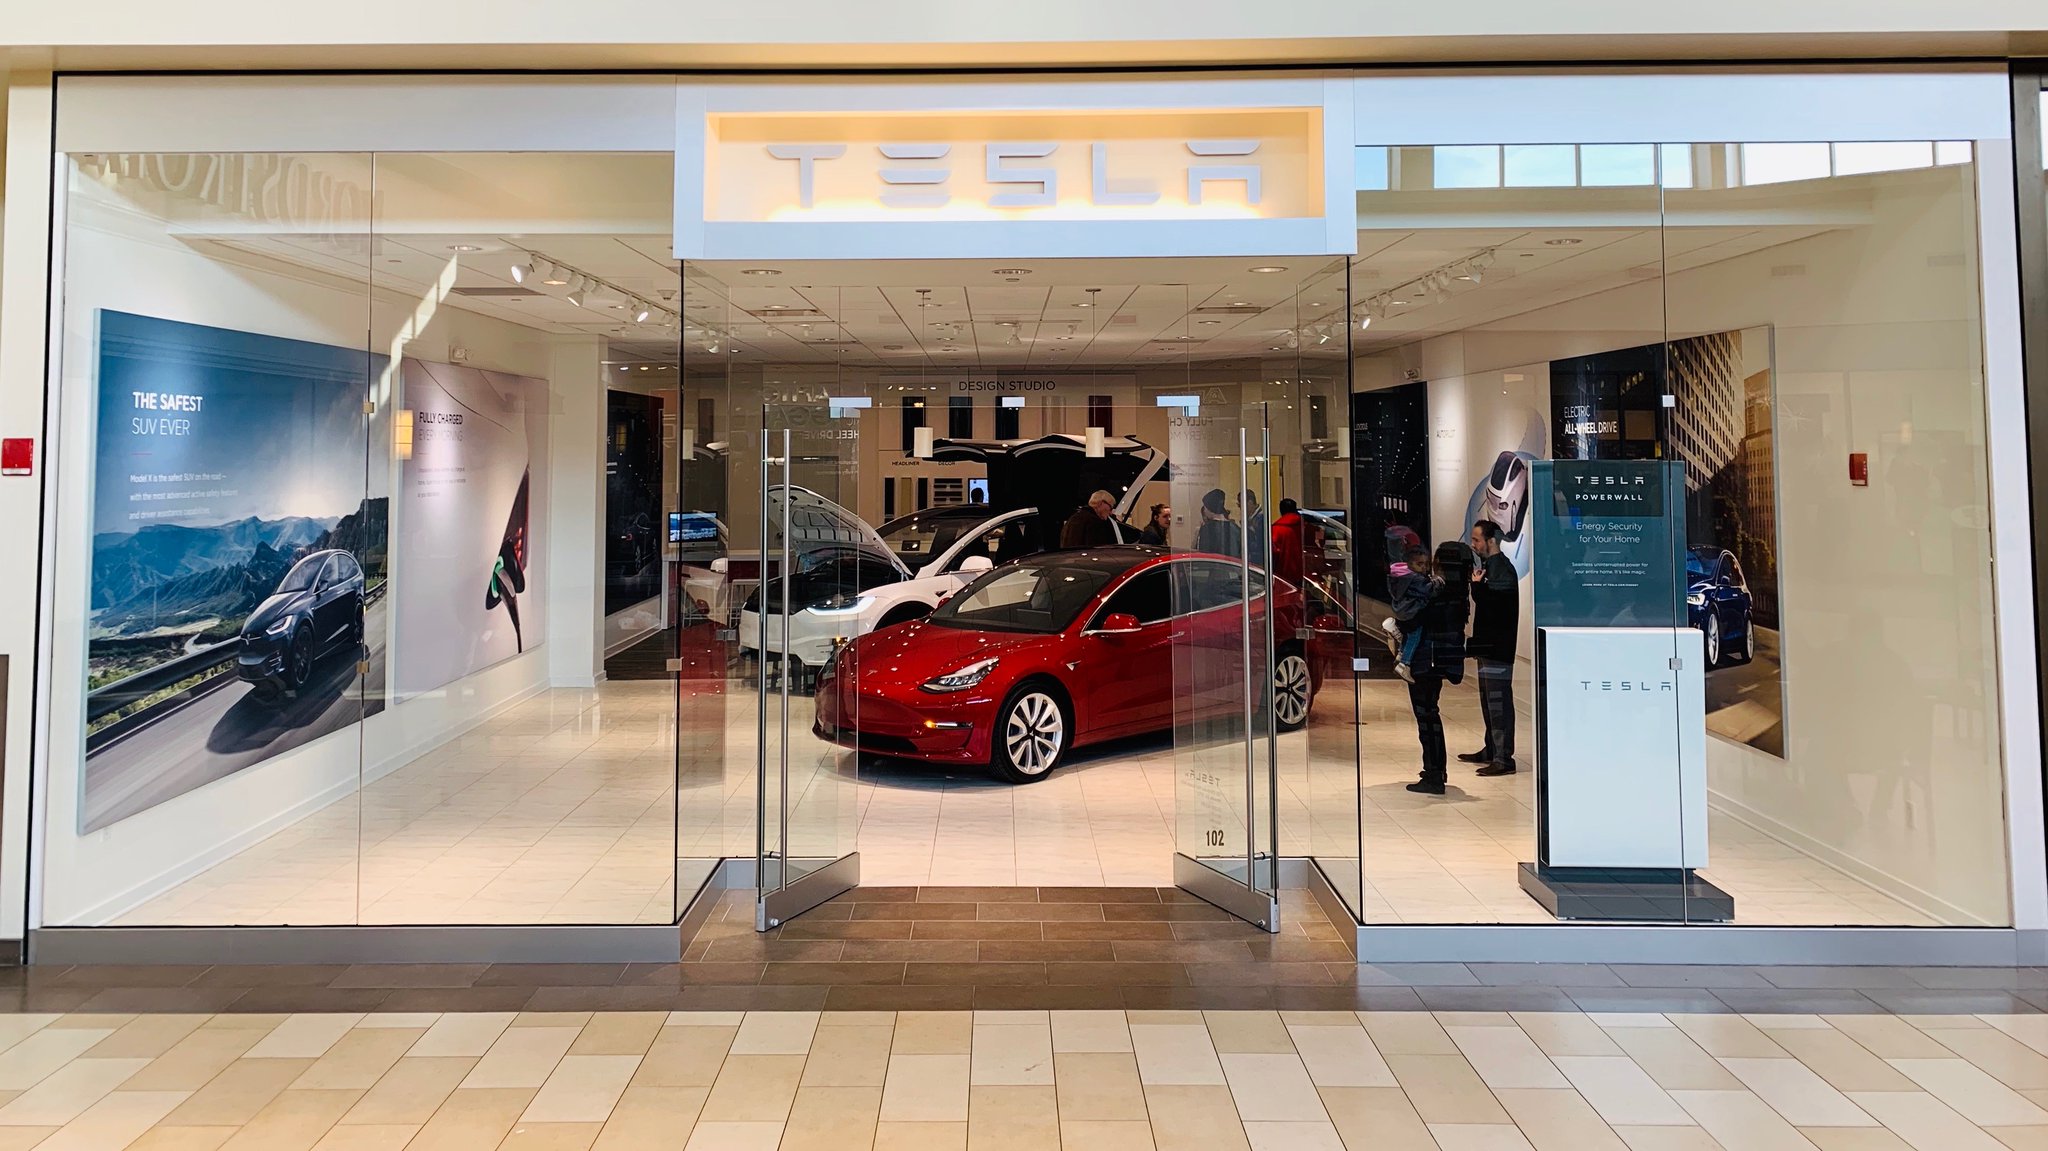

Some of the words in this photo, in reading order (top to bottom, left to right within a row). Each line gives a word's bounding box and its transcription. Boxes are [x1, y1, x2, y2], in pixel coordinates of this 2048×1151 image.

[766, 141, 1261, 208] TESLA
[959, 381, 1005, 391] DESIGN
[1009, 381, 1056, 391] STUDIO
[133, 392, 157, 409] THE
[160, 393, 203, 412] SAFEST
[419, 411, 437, 424] FULLY
[438, 413, 464, 425] CHARGED
[1563, 405, 1591, 419] ELECTRIC
[131, 417, 158, 435] SUV
[160, 418, 191, 436] EVER
[1564, 422, 1598, 435] ALL-WHEEL
[1598, 421, 1618, 434] DRIVE
[183, 472, 194, 481] SUV
[1574, 476, 1644, 485] TESLA
[1576, 521, 1607, 532] Energy
[1608, 521, 1643, 532] Security
[1579, 534, 1592, 543] for
[1593, 535, 1613, 543] Your
[1614, 535, 1641, 543] Home
[1580, 681, 1671, 691] TESLA
[1206, 830, 1224, 846] 102
